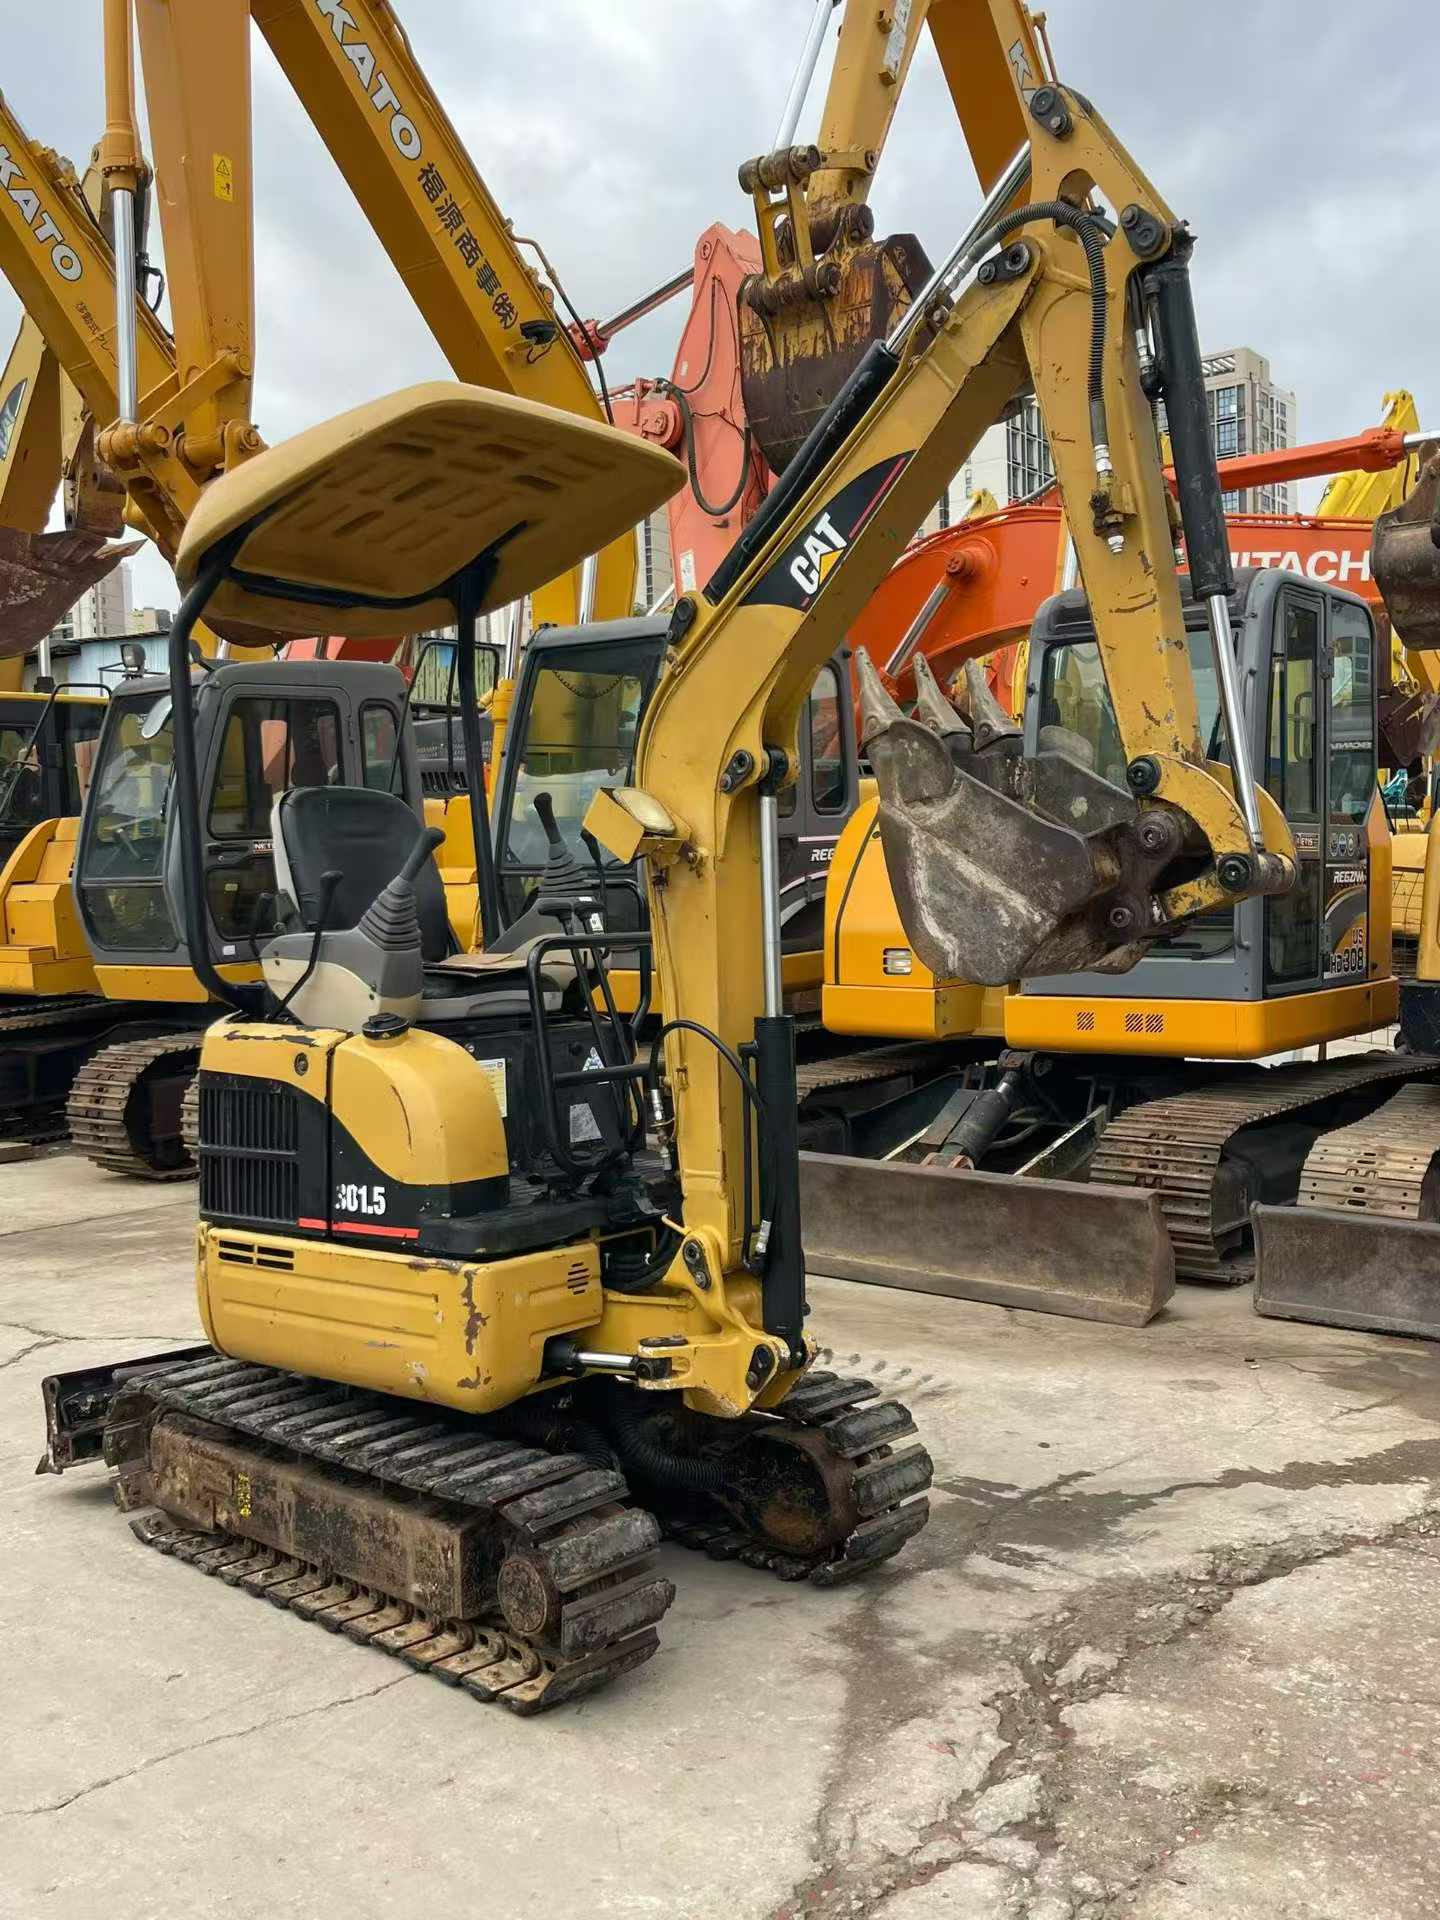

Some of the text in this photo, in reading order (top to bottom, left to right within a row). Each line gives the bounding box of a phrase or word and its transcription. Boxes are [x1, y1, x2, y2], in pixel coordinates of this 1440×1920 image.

[315, 0, 422, 161] KATO
[0, 144, 83, 281] KATO
[790, 511, 847, 595] CAT
[335, 1183, 386, 1216] 301.5
